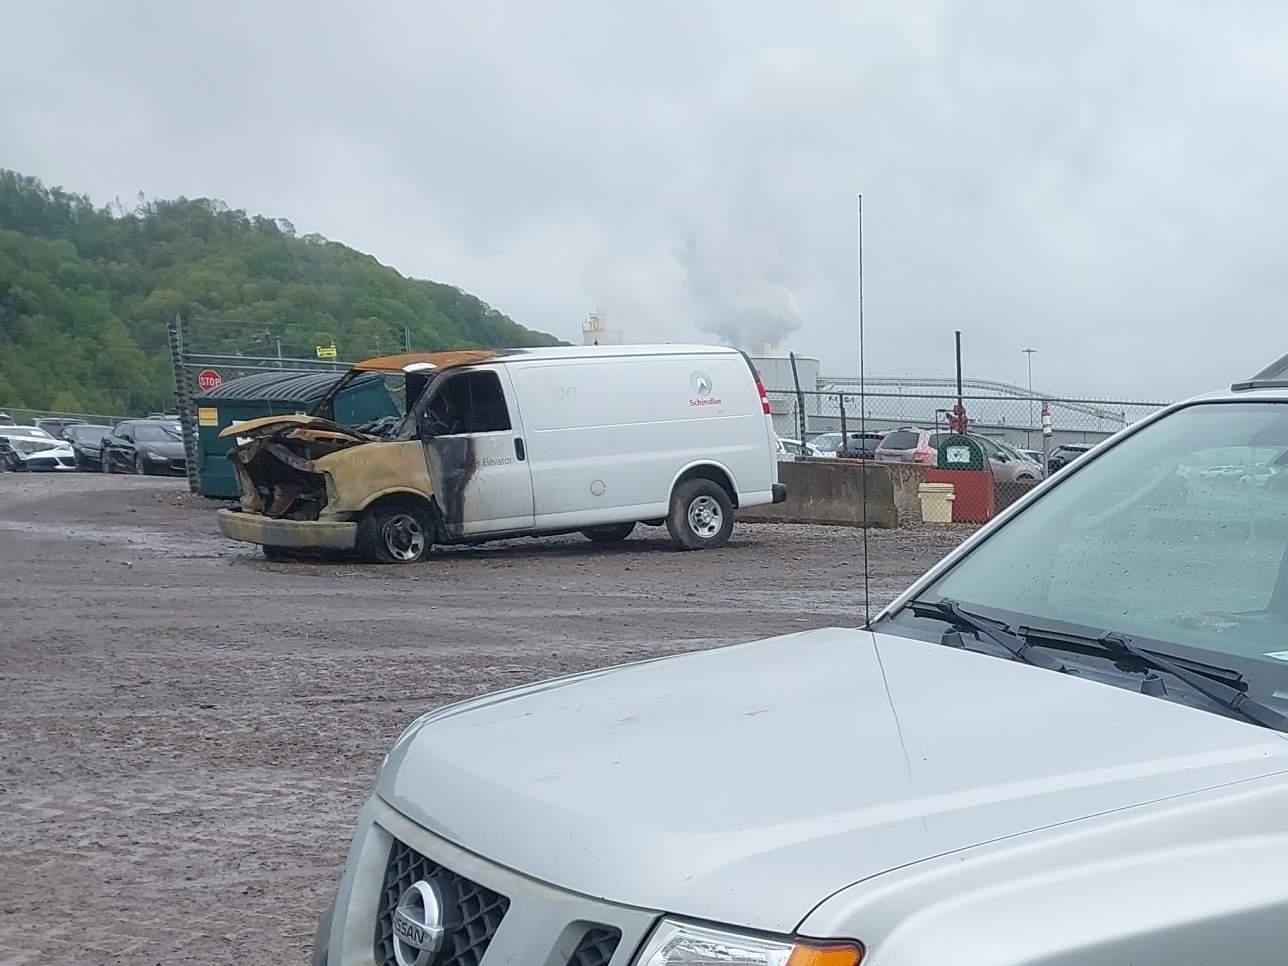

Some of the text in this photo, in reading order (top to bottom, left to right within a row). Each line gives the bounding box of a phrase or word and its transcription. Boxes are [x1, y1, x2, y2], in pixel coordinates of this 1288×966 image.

[200, 377, 220, 388] STOP
[689, 397, 722, 407] Schindler
[482, 456, 513, 467] Elevator
